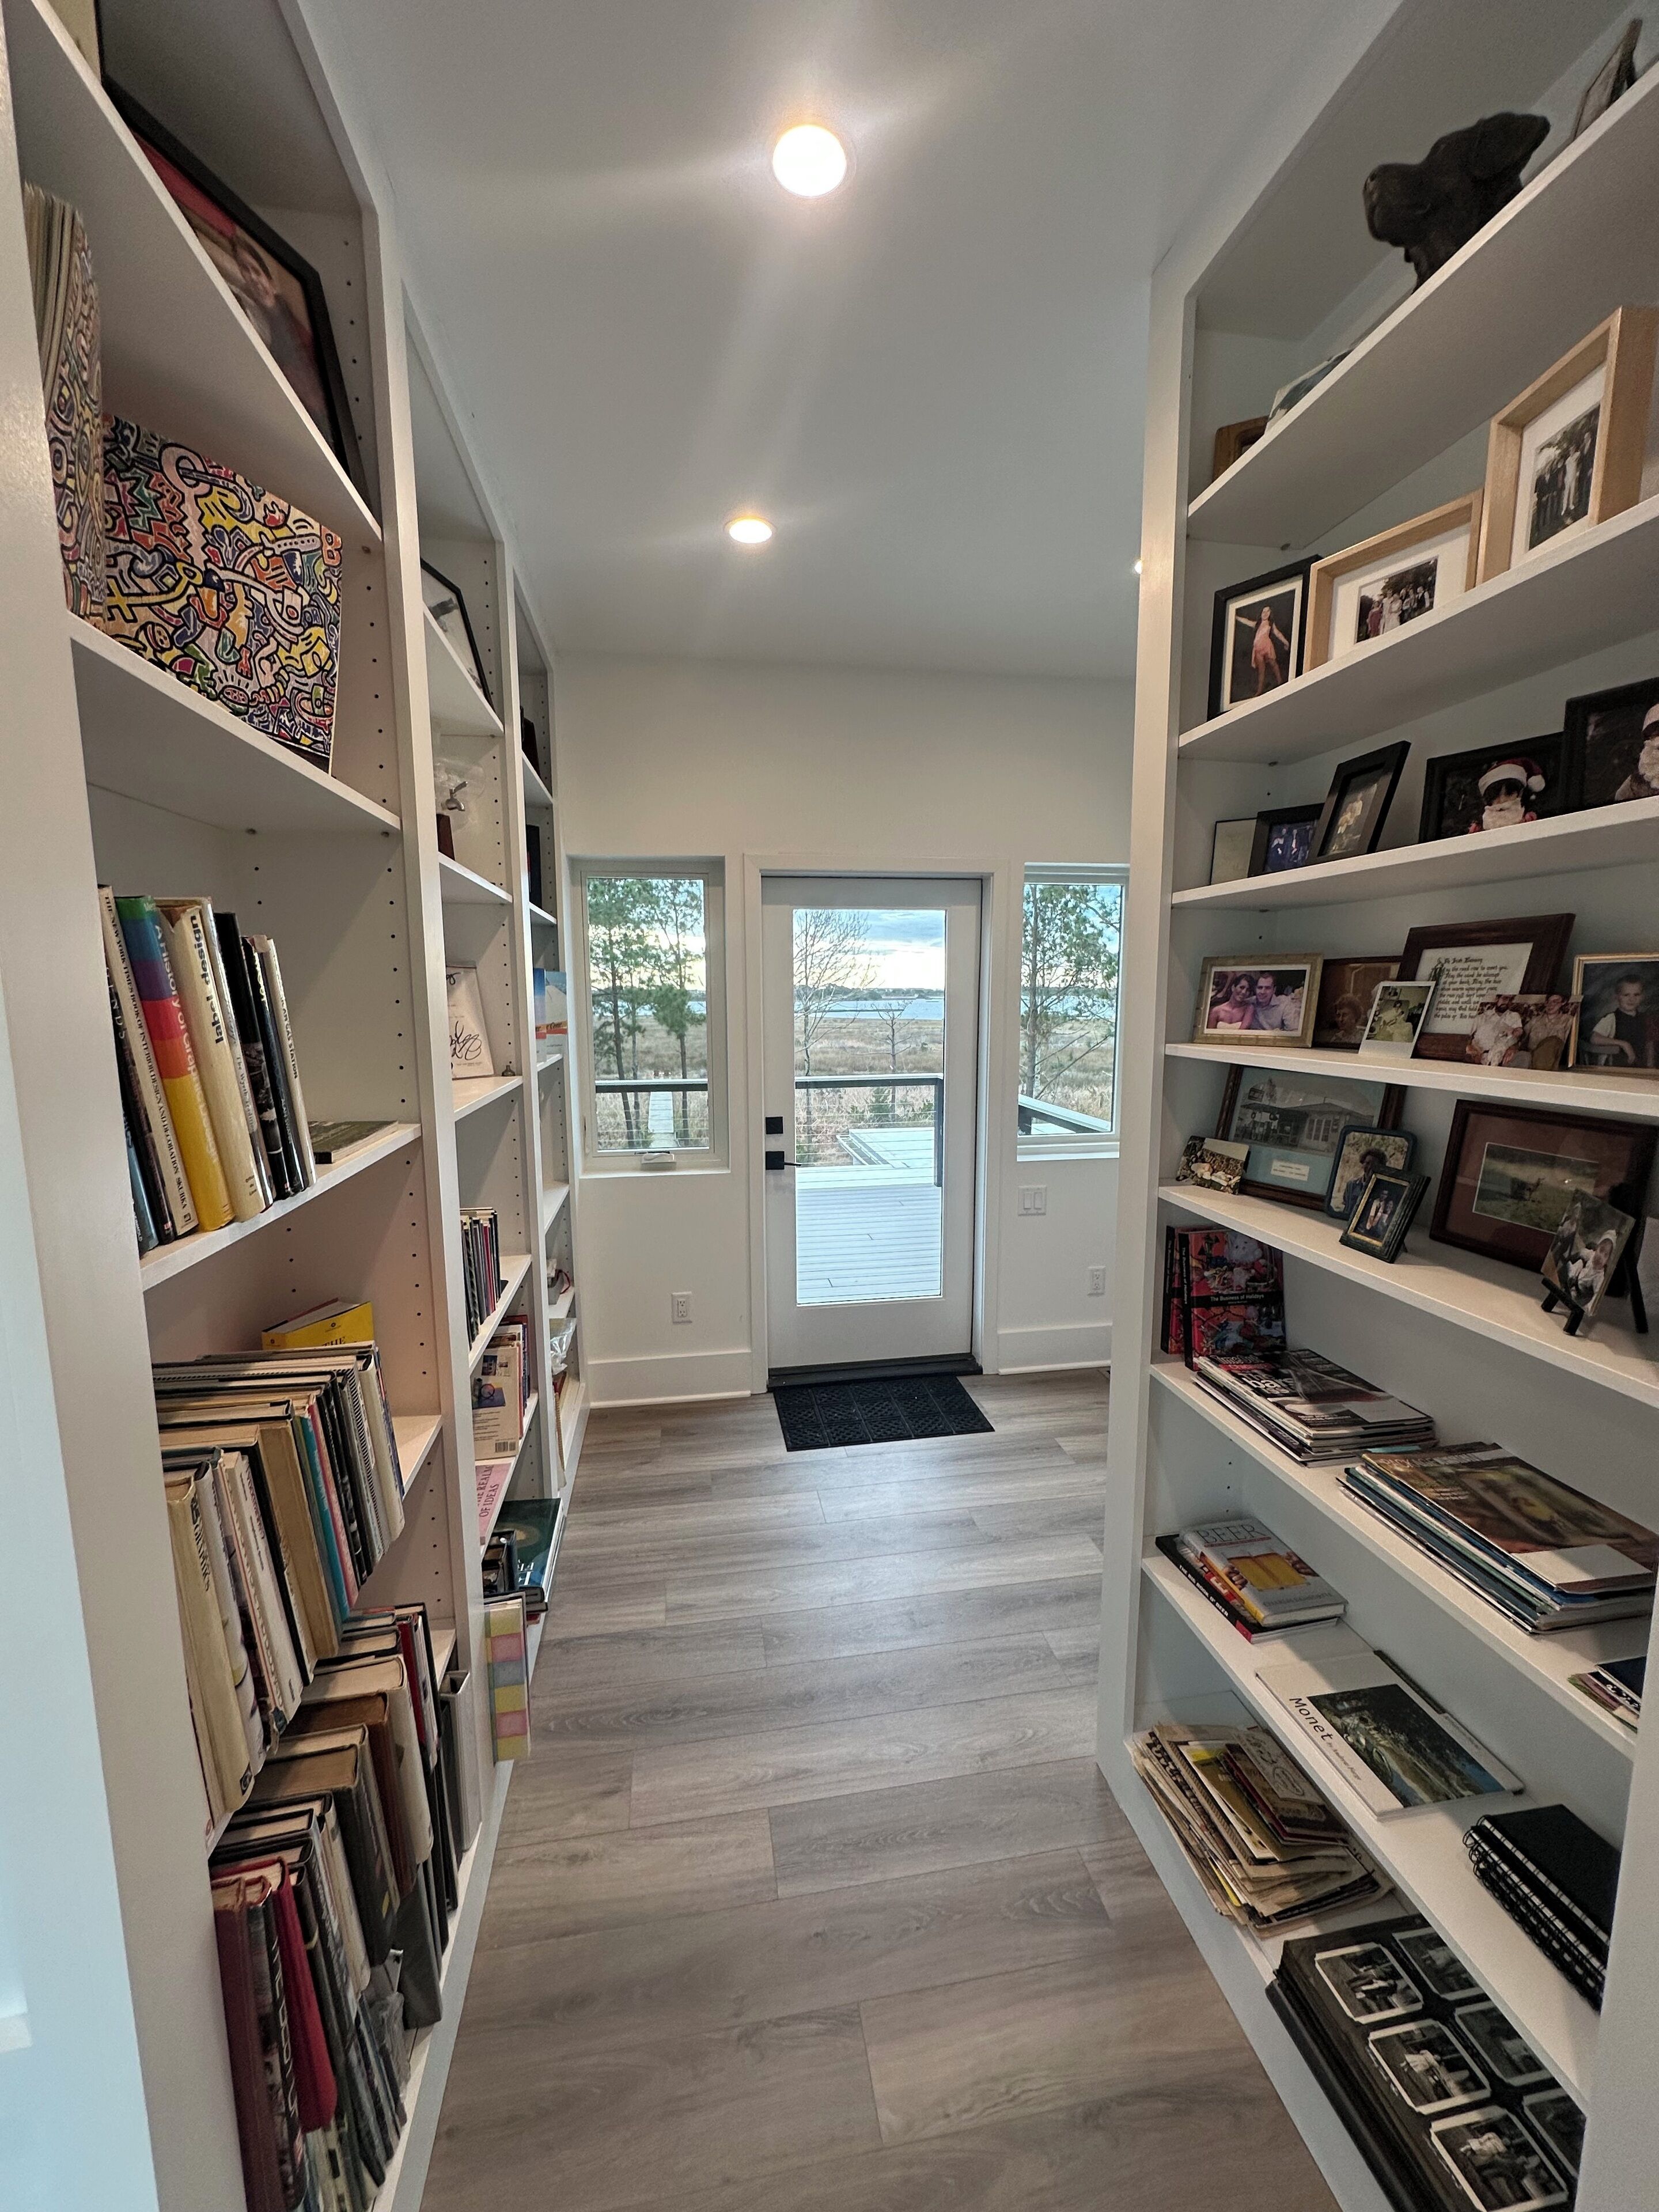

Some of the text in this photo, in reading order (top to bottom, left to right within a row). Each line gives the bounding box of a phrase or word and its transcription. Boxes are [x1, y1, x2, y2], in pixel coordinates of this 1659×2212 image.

[111, 917, 119, 940] NEW
[116, 940, 126, 964] YORK
[123, 966, 133, 992] TIMES
[155, 925, 162, 940] A
[160, 942, 181, 1008] History
[178, 1014, 187, 1030] of
[191, 915, 224, 1043] label design
[131, 995, 139, 1018] BOOK
[137, 1019, 142, 1029] OF
[139, 1031, 154, 1073] INTERIOR
[289, 1041, 298, 1079] STATION
[150, 1073, 161, 1104] DESIGN
[239, 1073, 249, 1100] Wyeth
[158, 1105, 166, 1122] AND
[162, 1122, 179, 1174] DECORATION
[479, 1484, 499, 1517] OF IDEAS
[1194, 1524, 1266, 1543] BEER
[1179, 1565, 1188, 1575] THE
[1188, 1574, 1196, 1584] BIG
[1196, 1582, 1209, 1597] BOOK
[1215, 1602, 1228, 1617] BEER
[1289, 1698, 1334, 1741] Monet
